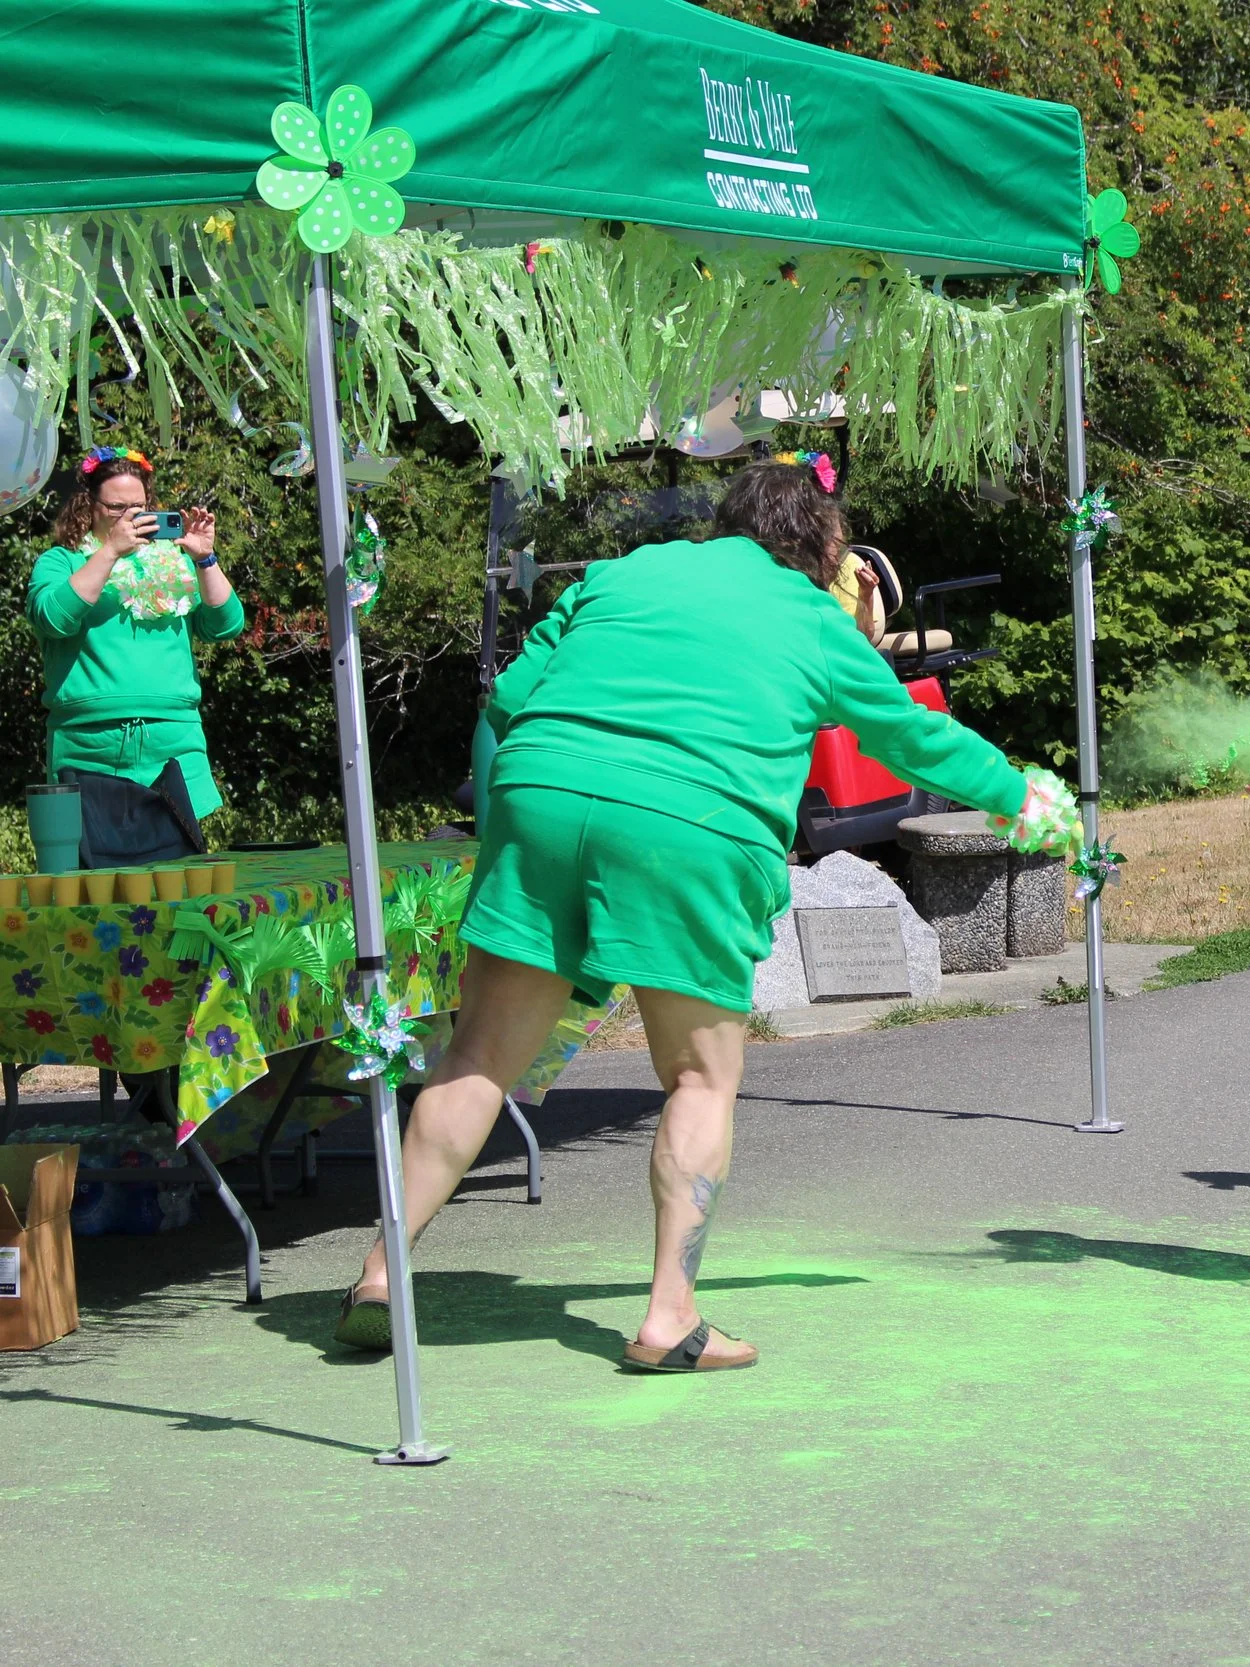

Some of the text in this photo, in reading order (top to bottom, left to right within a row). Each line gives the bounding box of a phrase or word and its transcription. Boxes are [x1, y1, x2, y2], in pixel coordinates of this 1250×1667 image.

[700, 67, 749, 146] BERRY
[757, 80, 798, 154] VALE
[707, 171, 818, 220] CONTRACTING LTD
